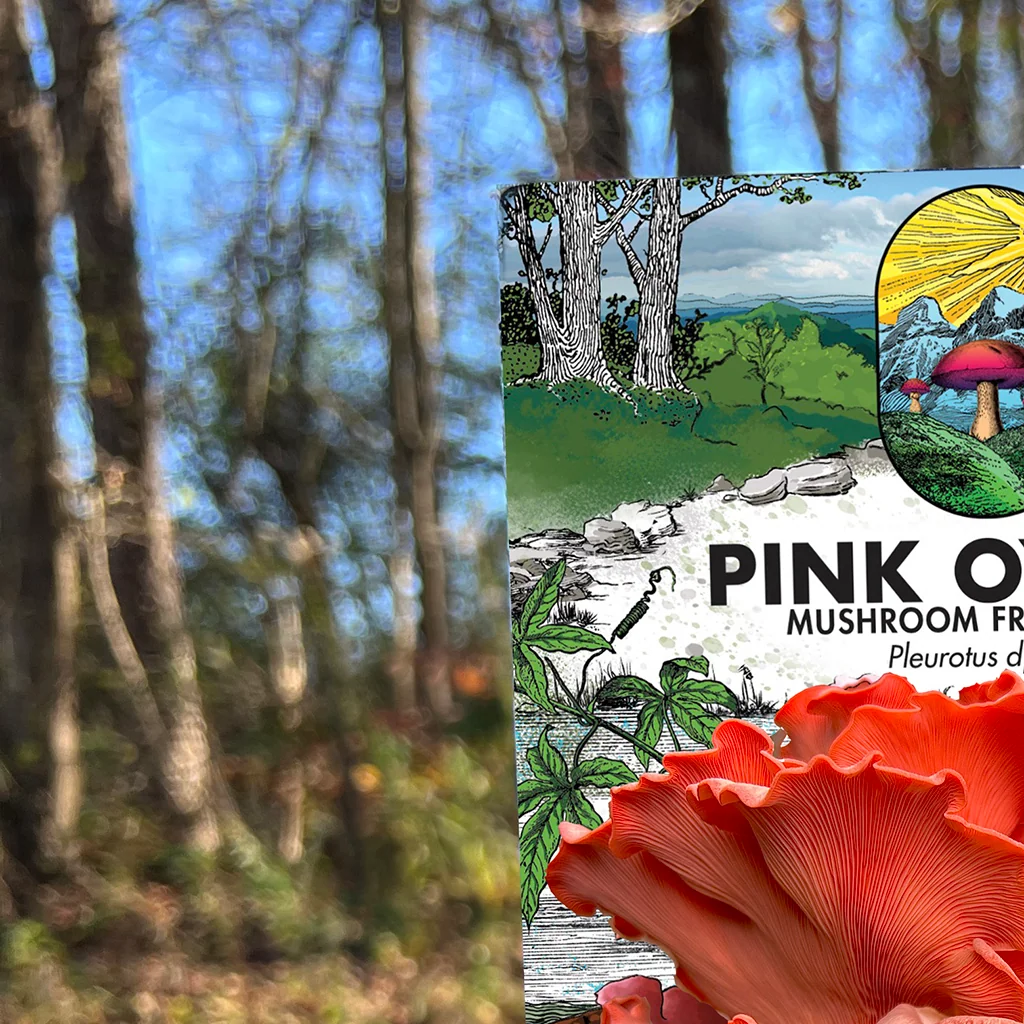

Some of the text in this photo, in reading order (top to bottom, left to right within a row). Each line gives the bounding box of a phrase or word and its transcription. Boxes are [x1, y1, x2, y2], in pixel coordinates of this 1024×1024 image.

[709, 540, 923, 606] PINK
[786, 605, 979, 635] MUSHROOM
[888, 641, 998, 669] Pleurotus
